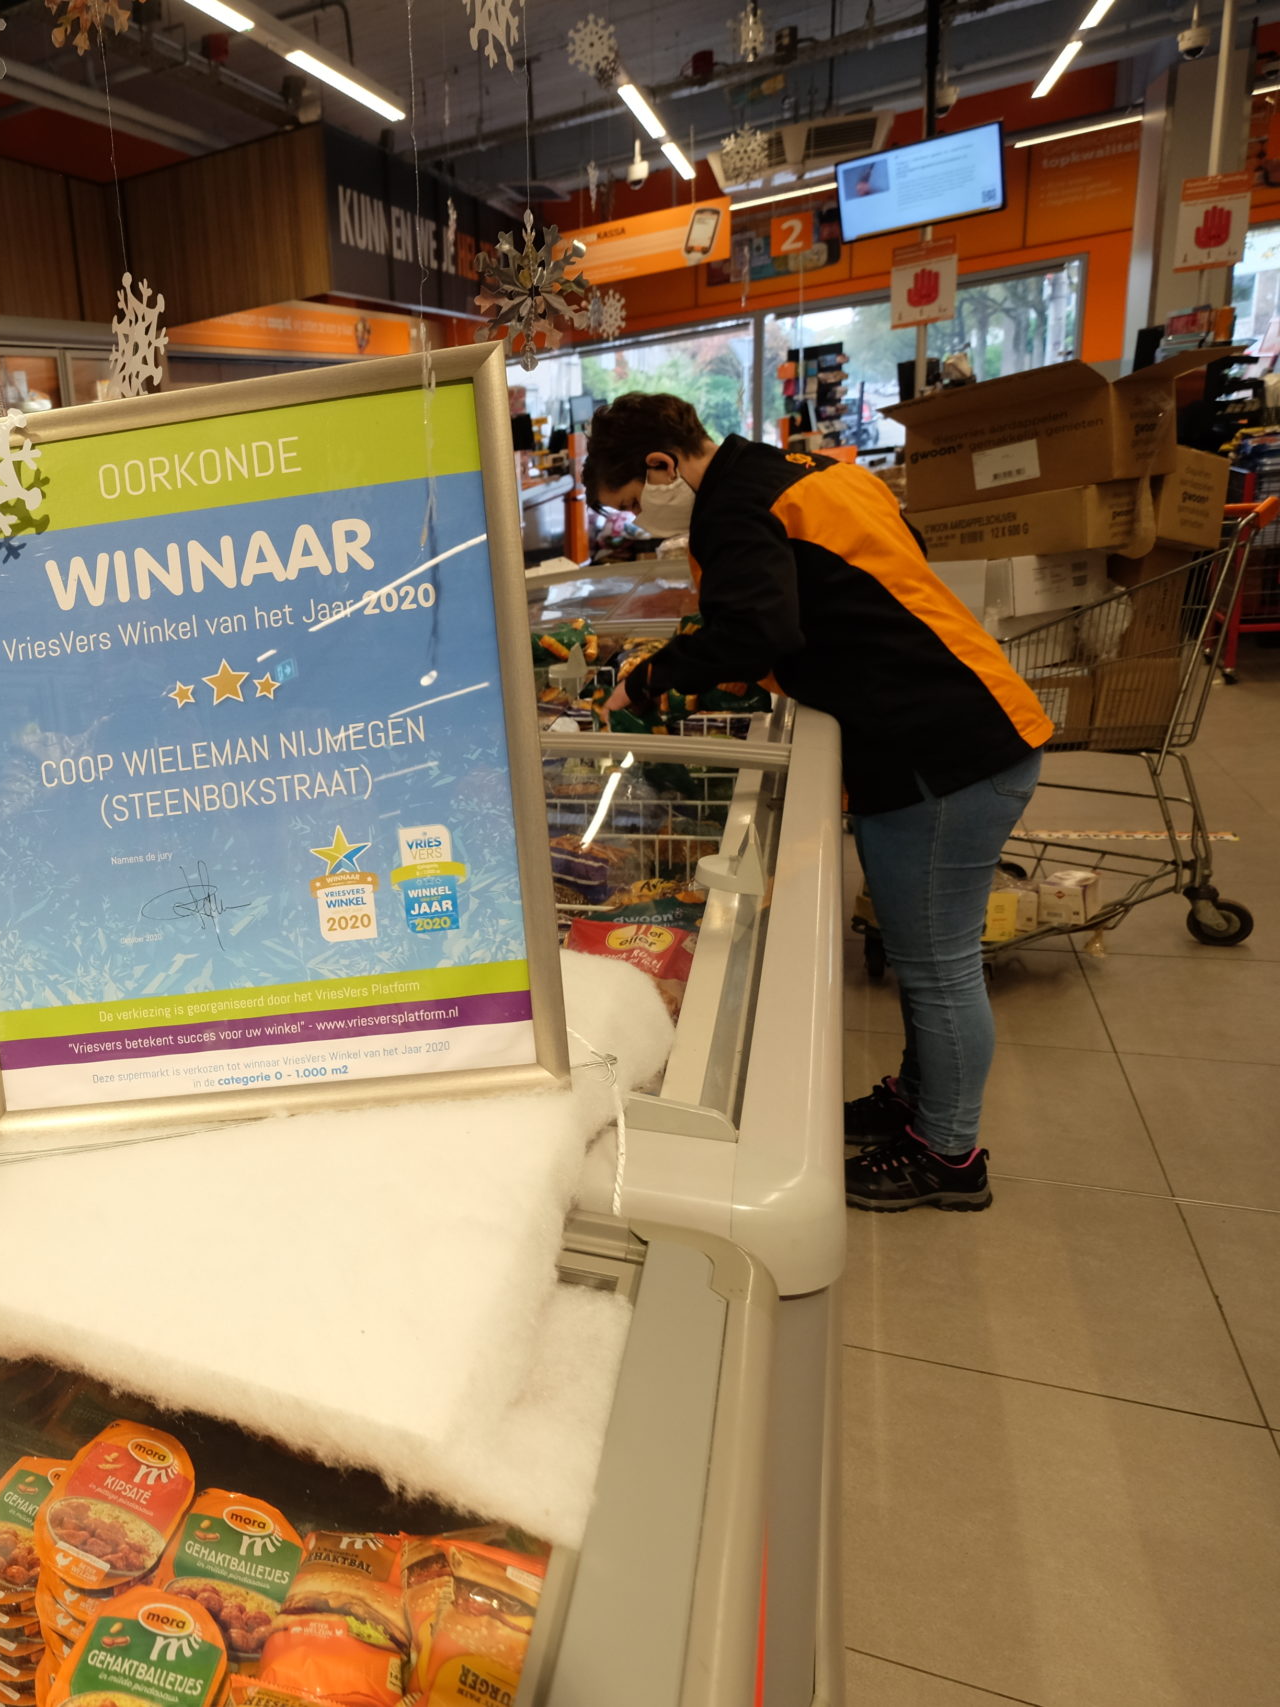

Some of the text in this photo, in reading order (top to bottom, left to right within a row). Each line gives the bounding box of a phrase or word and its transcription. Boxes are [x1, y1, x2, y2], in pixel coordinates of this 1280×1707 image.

[780, 219, 804, 252] 2
[98, 436, 302, 499] OORKONDE
[44, 518, 375, 611] WINNAAR
[2, 582, 436, 663] VriesVers Winkel van het Jaar 2020
[40, 716, 426, 788] COOP WIELEMAN NIJMEGEN
[100, 764, 374, 829] (STEENBOKSTRAAT)
[407, 837, 442, 851] VRIES
[411, 849, 443, 861] VERS
[111, 851, 174, 865] Namens de jury
[326, 873, 361, 884] WINNAAR
[324, 887, 366, 898] VRIESVERS
[326, 897, 367, 909] WINKEL
[408, 886, 452, 898] WINKEL
[410, 899, 453, 915] JAAR
[326, 913, 372, 932] 2020
[416, 917, 451, 932] 2020
[99, 980, 420, 1023] De verkiezing is georganiseerd door het VriesVers Platform
[69, 1039, 122, 1056] "Vriesvers
[125, 1034, 174, 1050] betekent
[177, 1032, 217, 1045] succes
[219, 1029, 243, 1041] voor
[245, 1027, 262, 1038] uw
[316, 1006, 459, 1032] www.vriesversplatform.nl
[92, 1040, 451, 1085] Deze supermarkt is verkozen tot winnaar VriesVers Winkel van het Jaar 2020
[193, 1078, 202, 1090] in
[204, 1076, 215, 1088] de
[217, 1071, 272, 1088] categorie
[295, 1066, 328, 1080] 1.000
[331, 1064, 350, 1077] m2
[134, 1443, 167, 1462] mora
[103, 1475, 152, 1505] KIPSATÉ
[230, 1511, 267, 1530] mora
[185, 1540, 291, 1584] GEHAKTBALLETJES
[145, 1611, 186, 1630] mora
[87, 1649, 204, 1696] GEHAKTBALLETJES
